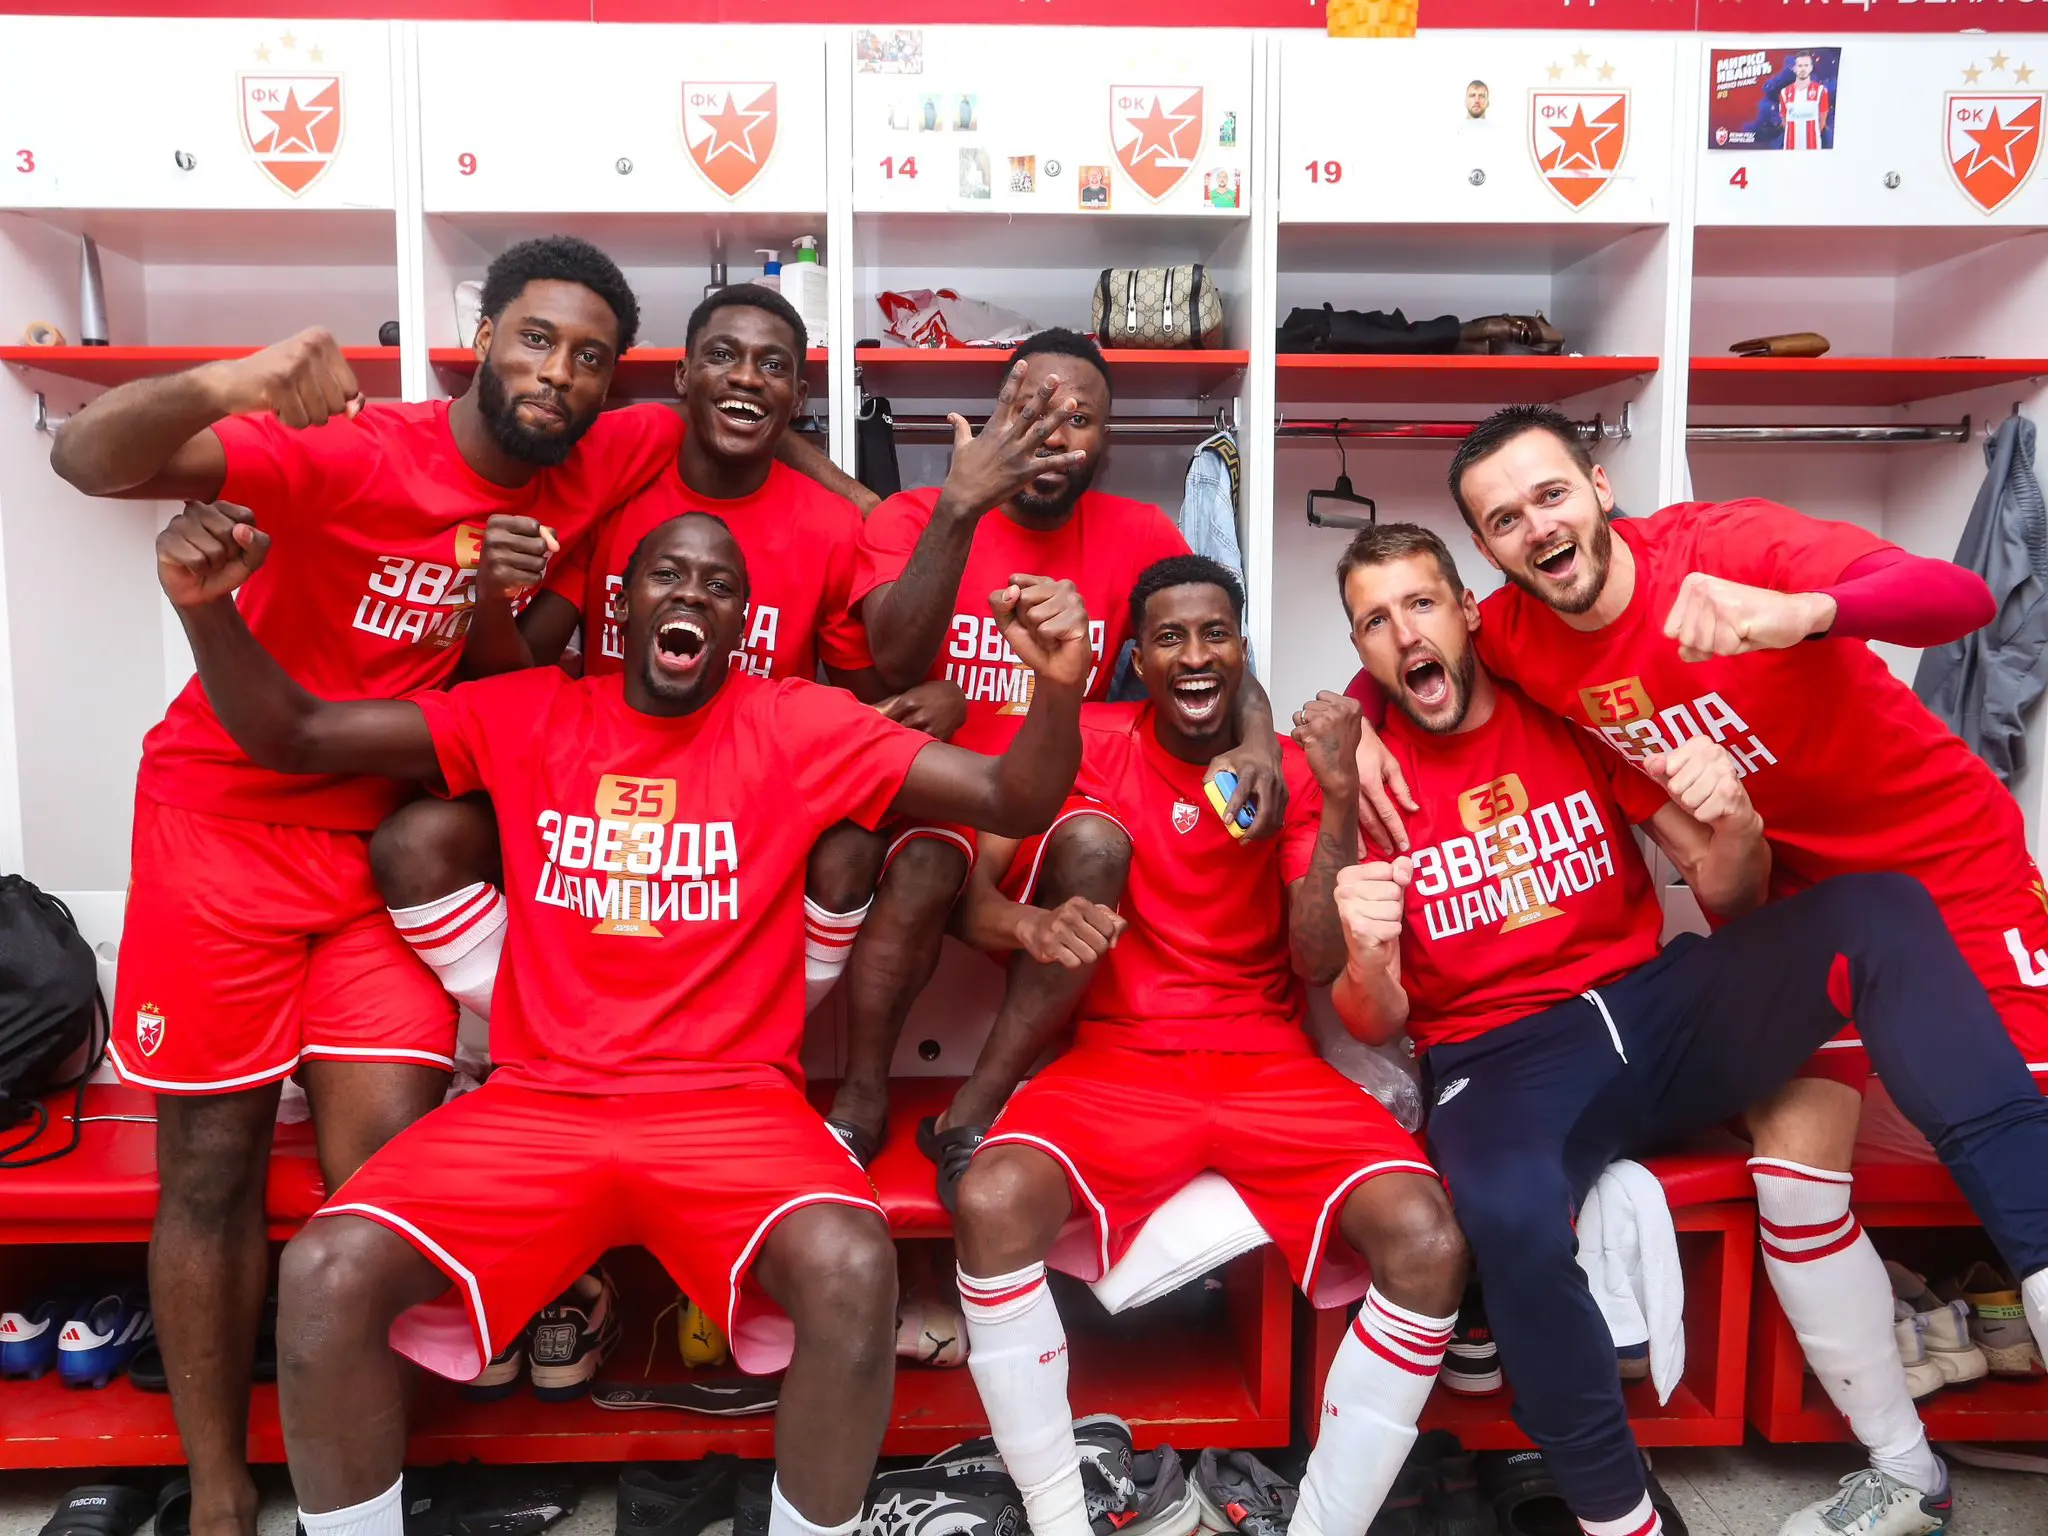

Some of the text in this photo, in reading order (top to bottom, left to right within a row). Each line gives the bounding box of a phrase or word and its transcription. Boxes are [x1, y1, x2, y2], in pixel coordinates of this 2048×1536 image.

[251, 87, 280, 104] ФК
[690, 93, 718, 108] ФК
[1118, 96, 1145, 111] ФК
[1540, 104, 1568, 120] ФК
[1956, 106, 1984, 123] ФК
[16, 150, 36, 174] 3
[457, 152, 478, 176] 9
[880, 156, 918, 179] 14
[1304, 160, 1343, 185] 19
[1729, 166, 1749, 190] 4
[1591, 684, 1640, 723] 35
[1600, 691, 1750, 762] ЕЗДА
[611, 781, 664, 818] 35
[1469, 780, 1515, 825] 35
[536, 809, 739, 881] ЗВЕЗДА
[1411, 789, 1605, 897] ЗВЕЗДА
[535, 861, 738, 922] ШАМПИОН
[1424, 840, 1615, 941] ШАМПИОН
[1507, 1452, 1543, 1465] macron
[69, 1497, 107, 1509] macron
